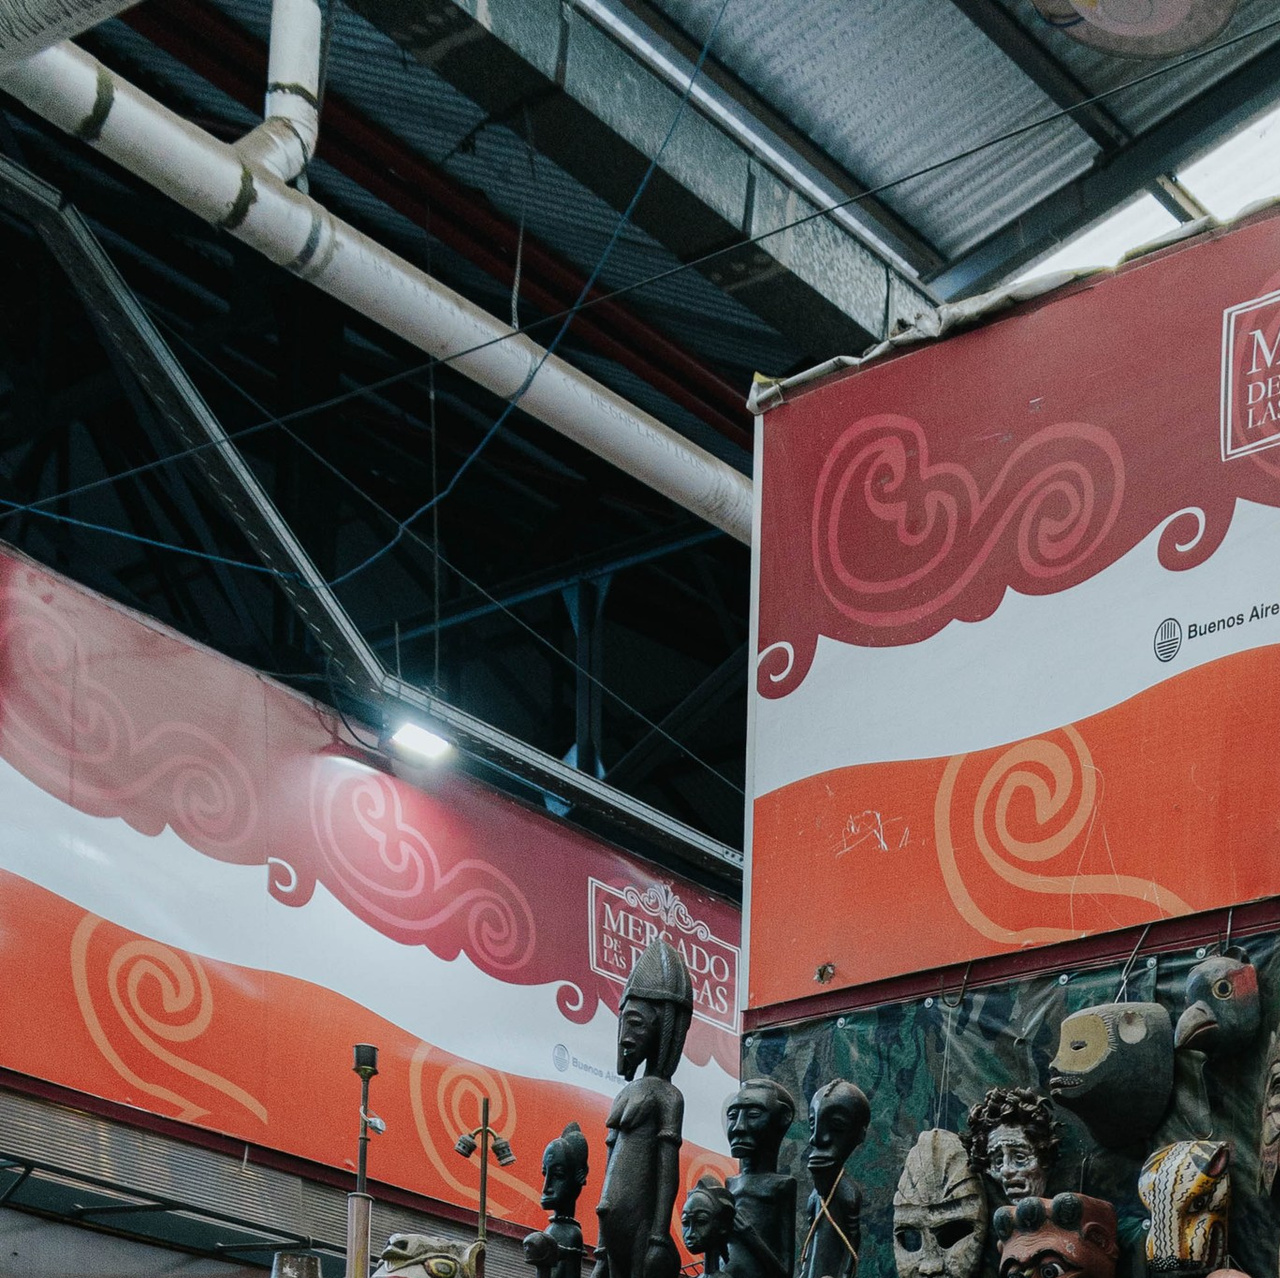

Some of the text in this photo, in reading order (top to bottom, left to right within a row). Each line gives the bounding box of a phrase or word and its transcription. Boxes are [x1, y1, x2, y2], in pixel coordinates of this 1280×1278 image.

[1187, 612, 1245, 640] Buenos
[603, 933, 622, 954] DE
[603, 948, 627, 970] LAS
[571, 1056, 604, 1079] Buenos
